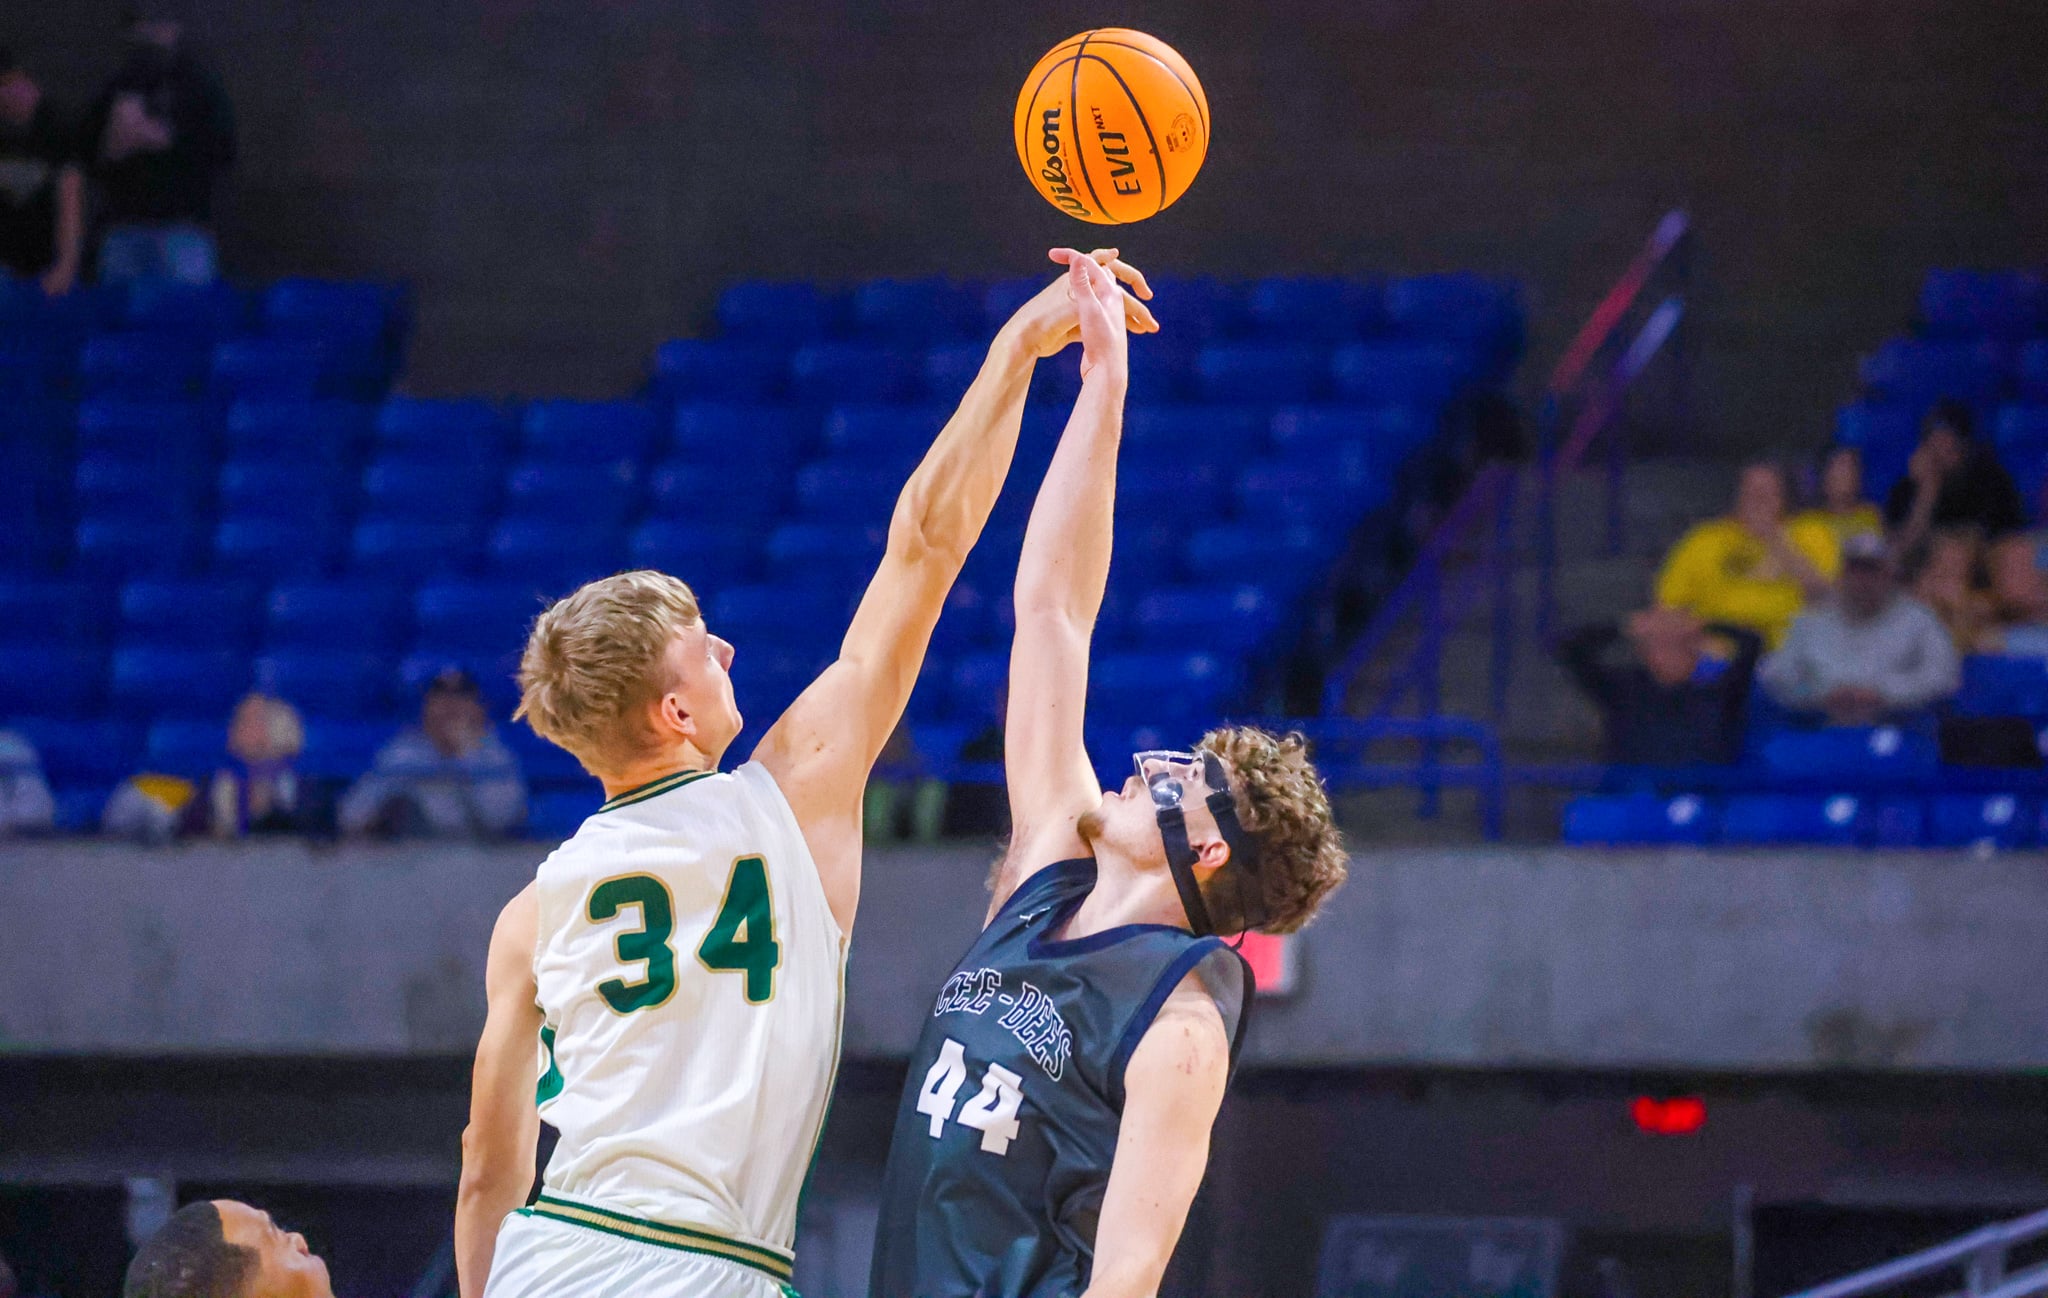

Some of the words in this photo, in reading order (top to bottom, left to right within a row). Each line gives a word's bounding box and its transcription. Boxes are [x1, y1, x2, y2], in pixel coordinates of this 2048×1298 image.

[1042, 108, 1092, 216] Wilson
[1091, 105, 1106, 130] NXT
[585, 853, 782, 1017] 34
[916, 1038, 1024, 1156] 44
